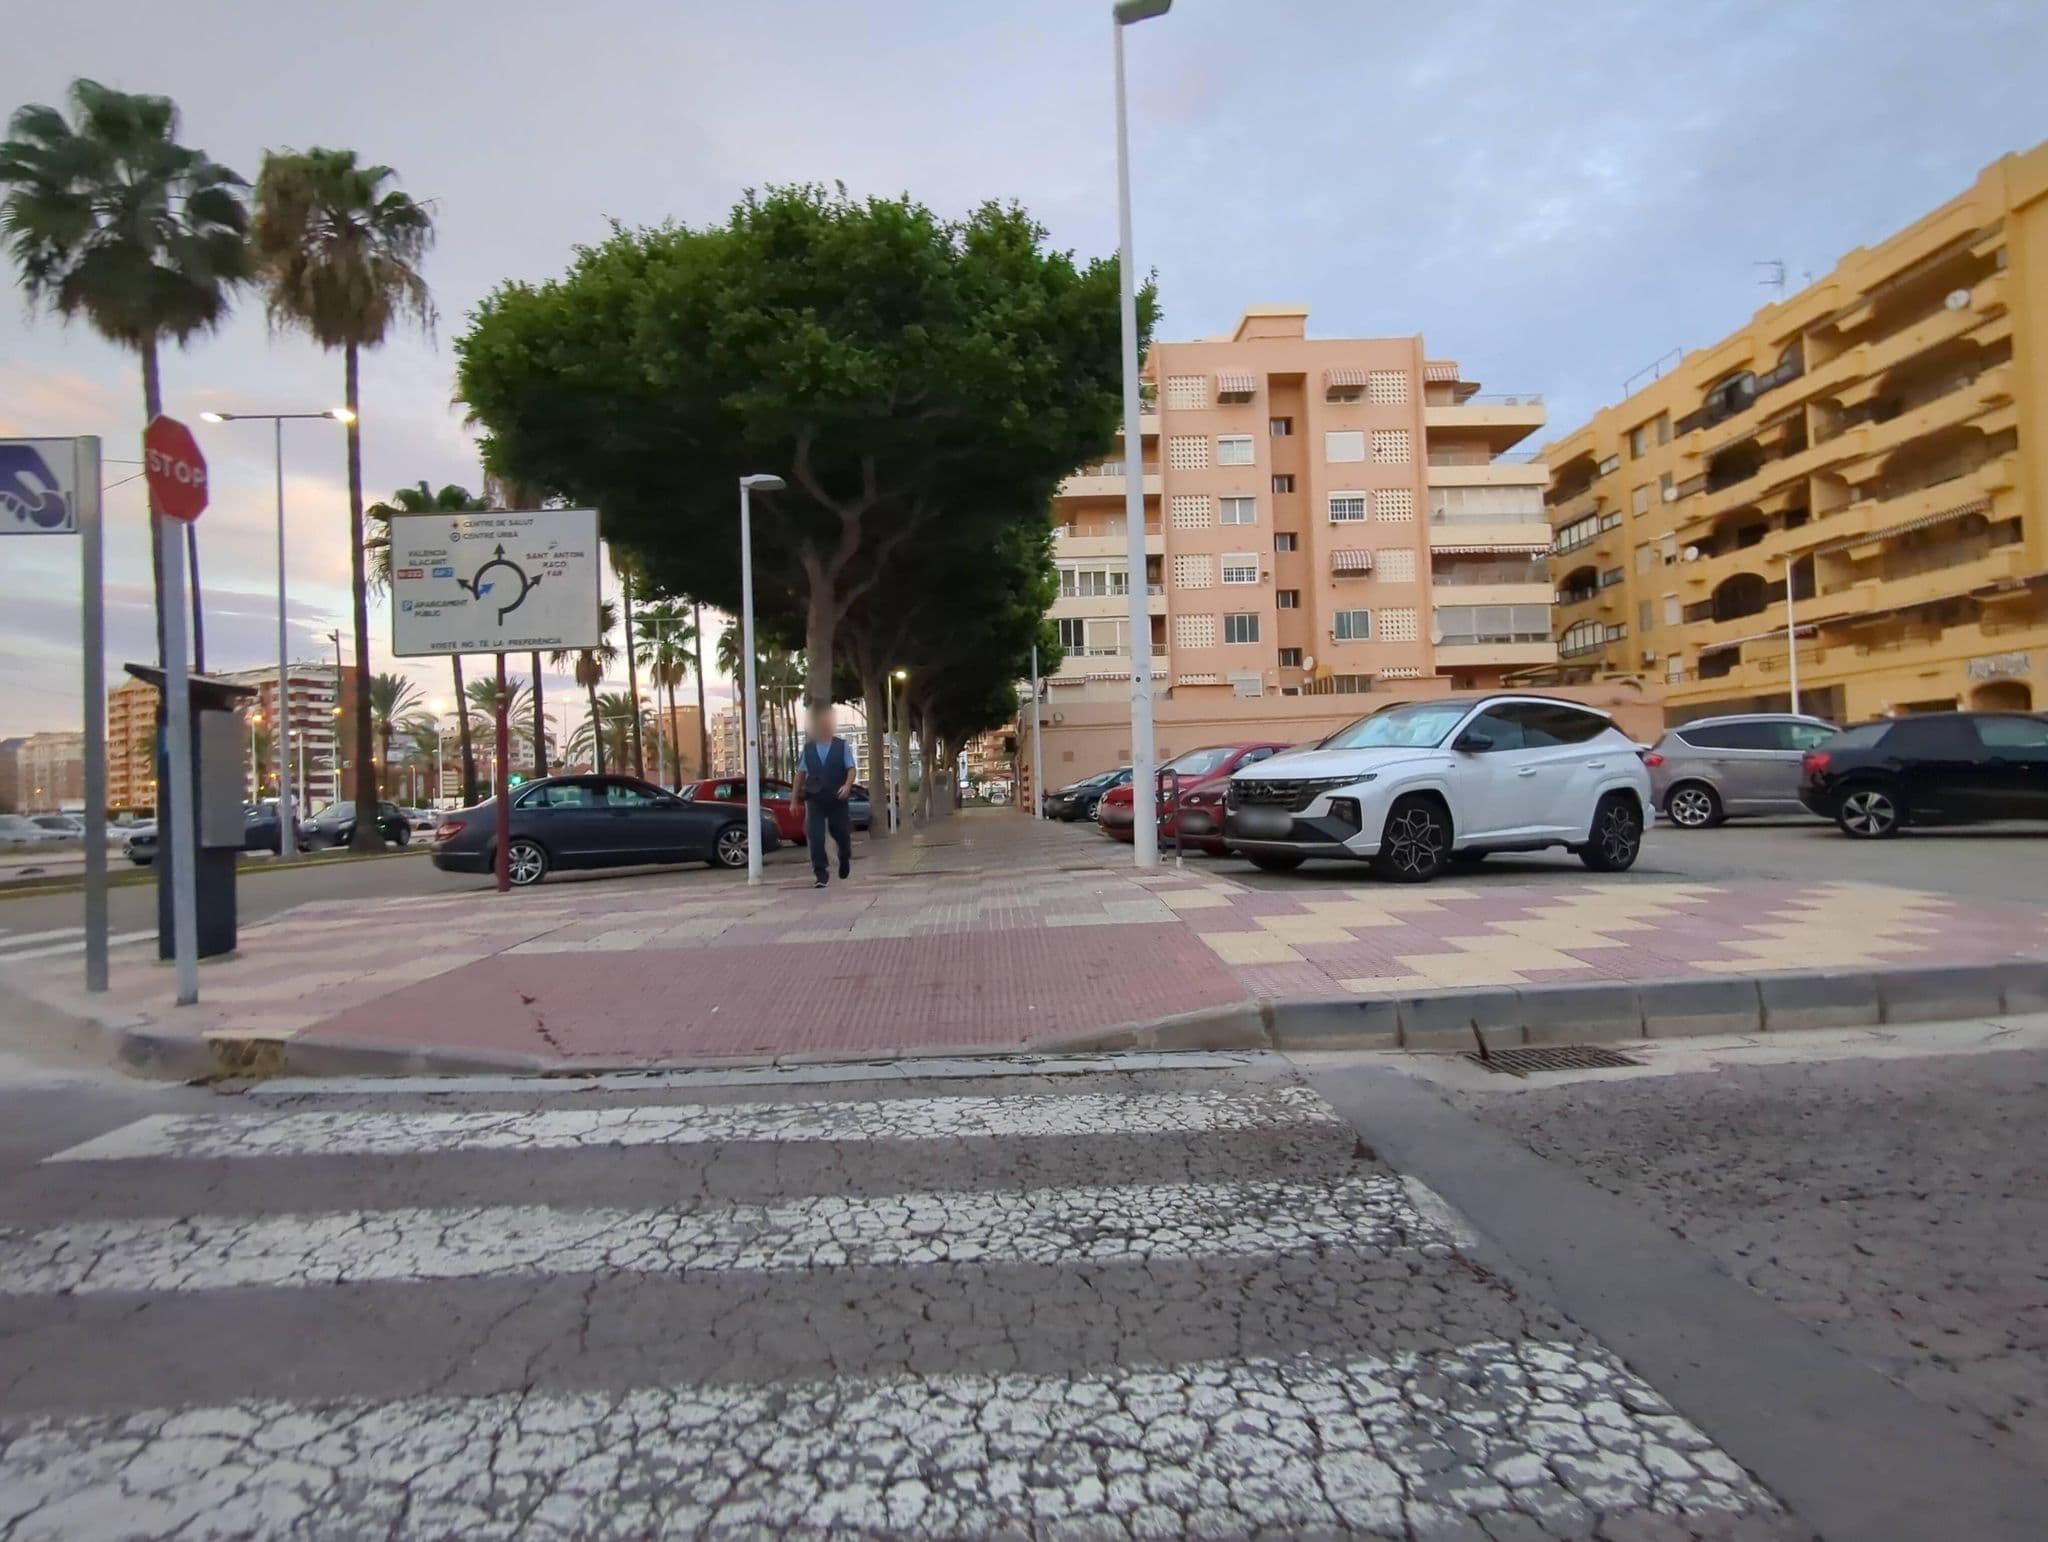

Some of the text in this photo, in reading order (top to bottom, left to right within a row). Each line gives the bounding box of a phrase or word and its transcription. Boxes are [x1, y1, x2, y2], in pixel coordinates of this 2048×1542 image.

[149, 448, 205, 488] STOP
[463, 520, 494, 528] CENTRE
[463, 532, 495, 540] CENTRE
